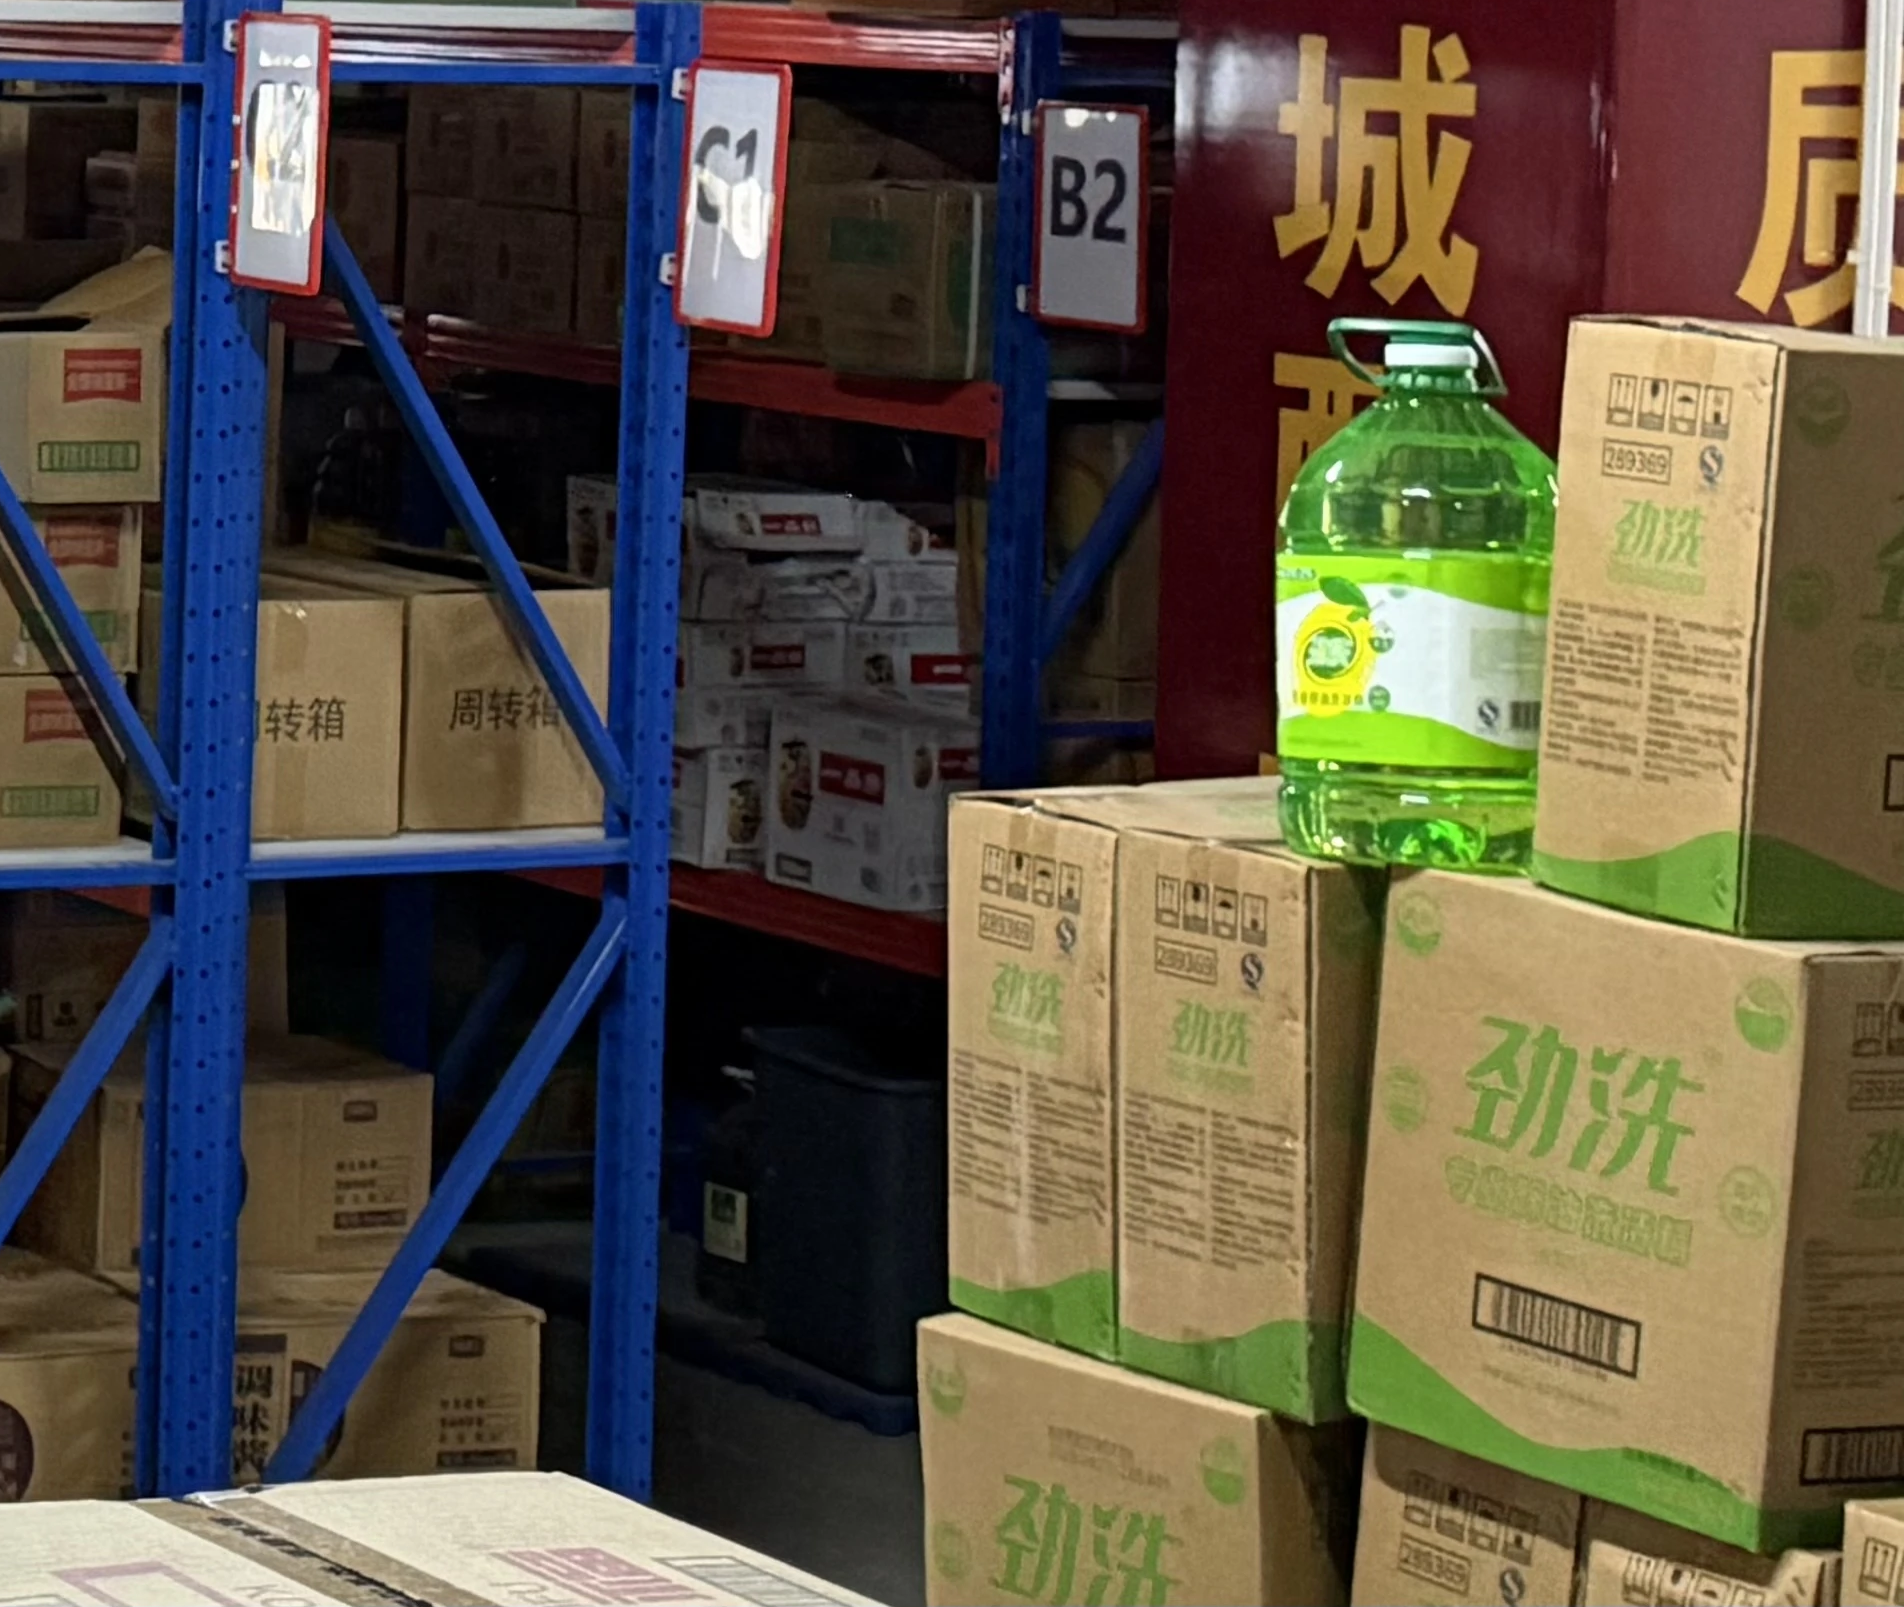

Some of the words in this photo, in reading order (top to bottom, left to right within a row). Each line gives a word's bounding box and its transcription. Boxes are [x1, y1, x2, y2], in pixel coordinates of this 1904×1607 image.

[695, 125, 761, 228] C1
[1049, 156, 1128, 245] B2
[1605, 445, 1668, 476] 289369
[1613, 498, 1706, 568] 劲洗
[448, 685, 564, 734] 周转箱
[993, 960, 1065, 1026] 劲洗
[1171, 997, 1252, 1068] 劲洗
[1453, 1015, 1706, 1196] 劲洗
[989, 1473, 1185, 1607] 劲洗
